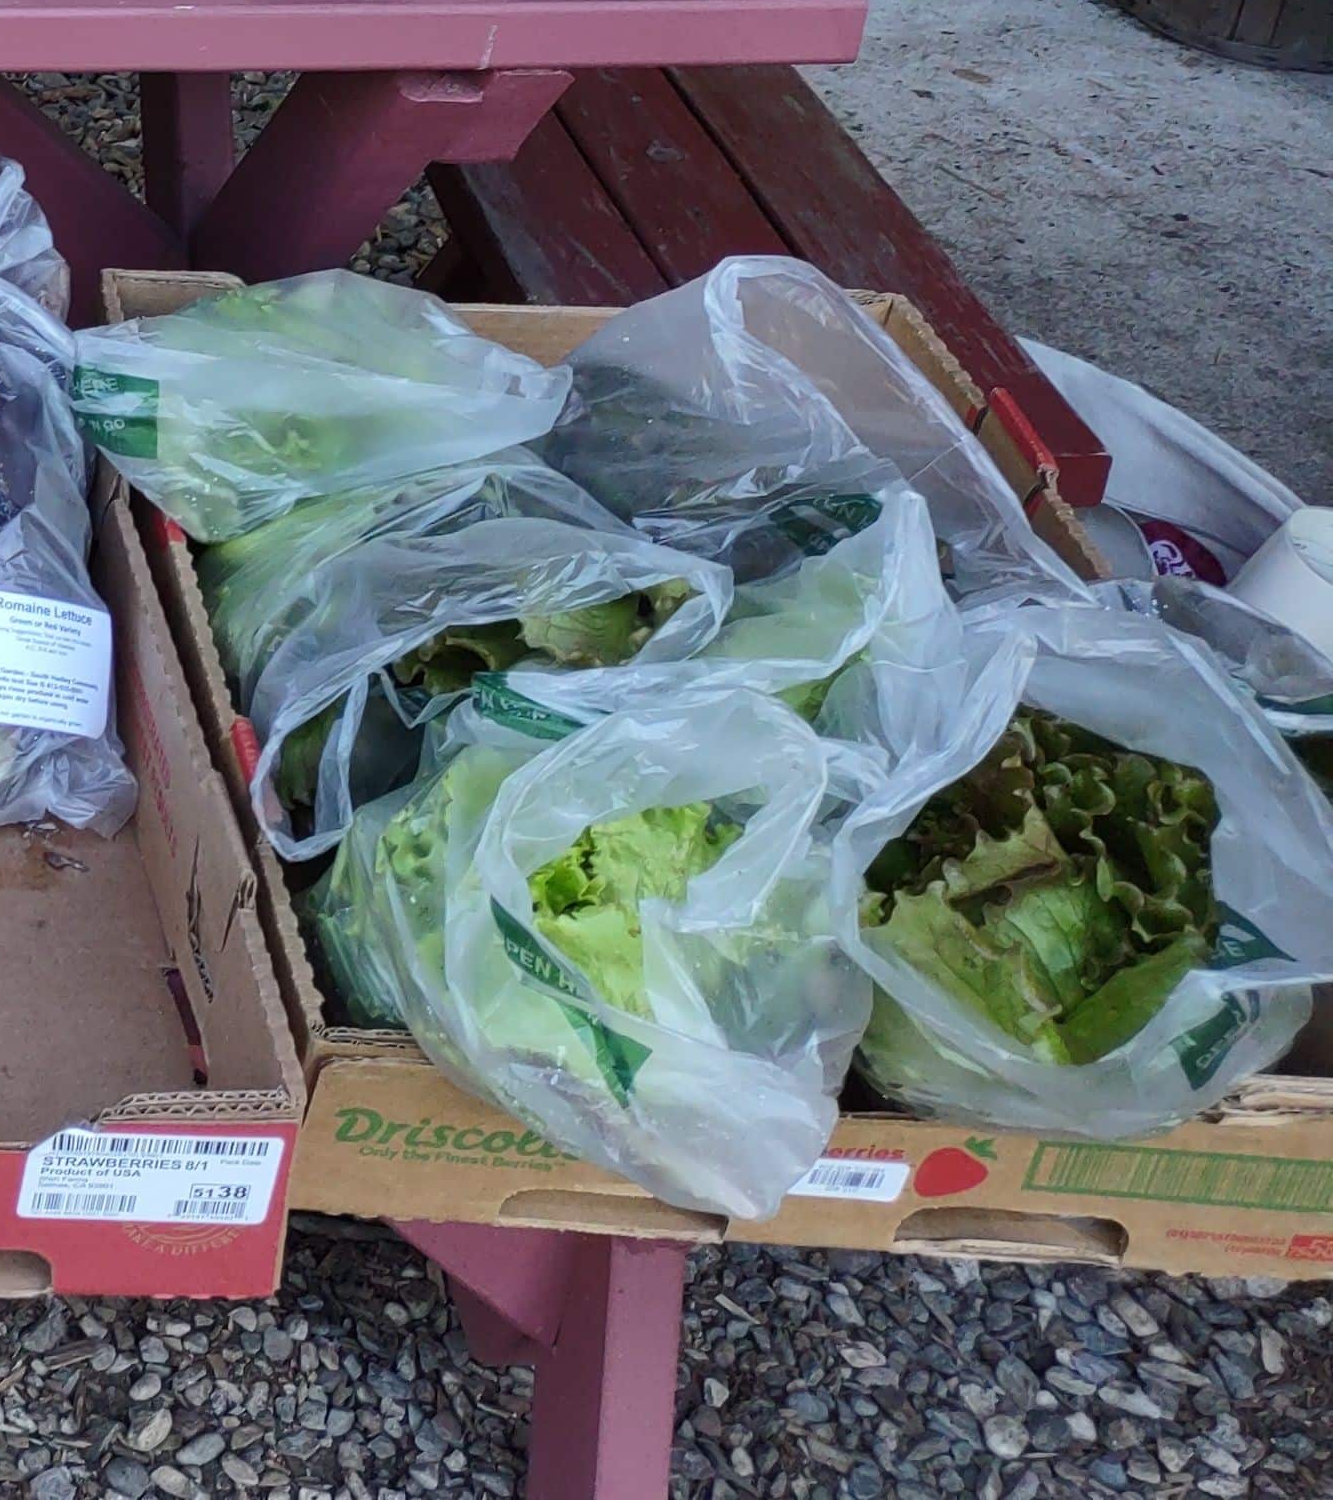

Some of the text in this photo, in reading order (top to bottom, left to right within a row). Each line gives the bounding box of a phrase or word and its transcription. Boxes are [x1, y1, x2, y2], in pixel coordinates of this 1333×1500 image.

[102, 418, 126, 432] GO
[53, 604, 93, 627] Lettuce
[9, 615, 82, 637] Green or Red Variety
[505, 936, 551, 981] PEN
[359, 1146, 397, 1161] Only
[42, 1155, 209, 1171] STRAWBERRIES 8/1
[40, 1167, 142, 1178] Product of USA
